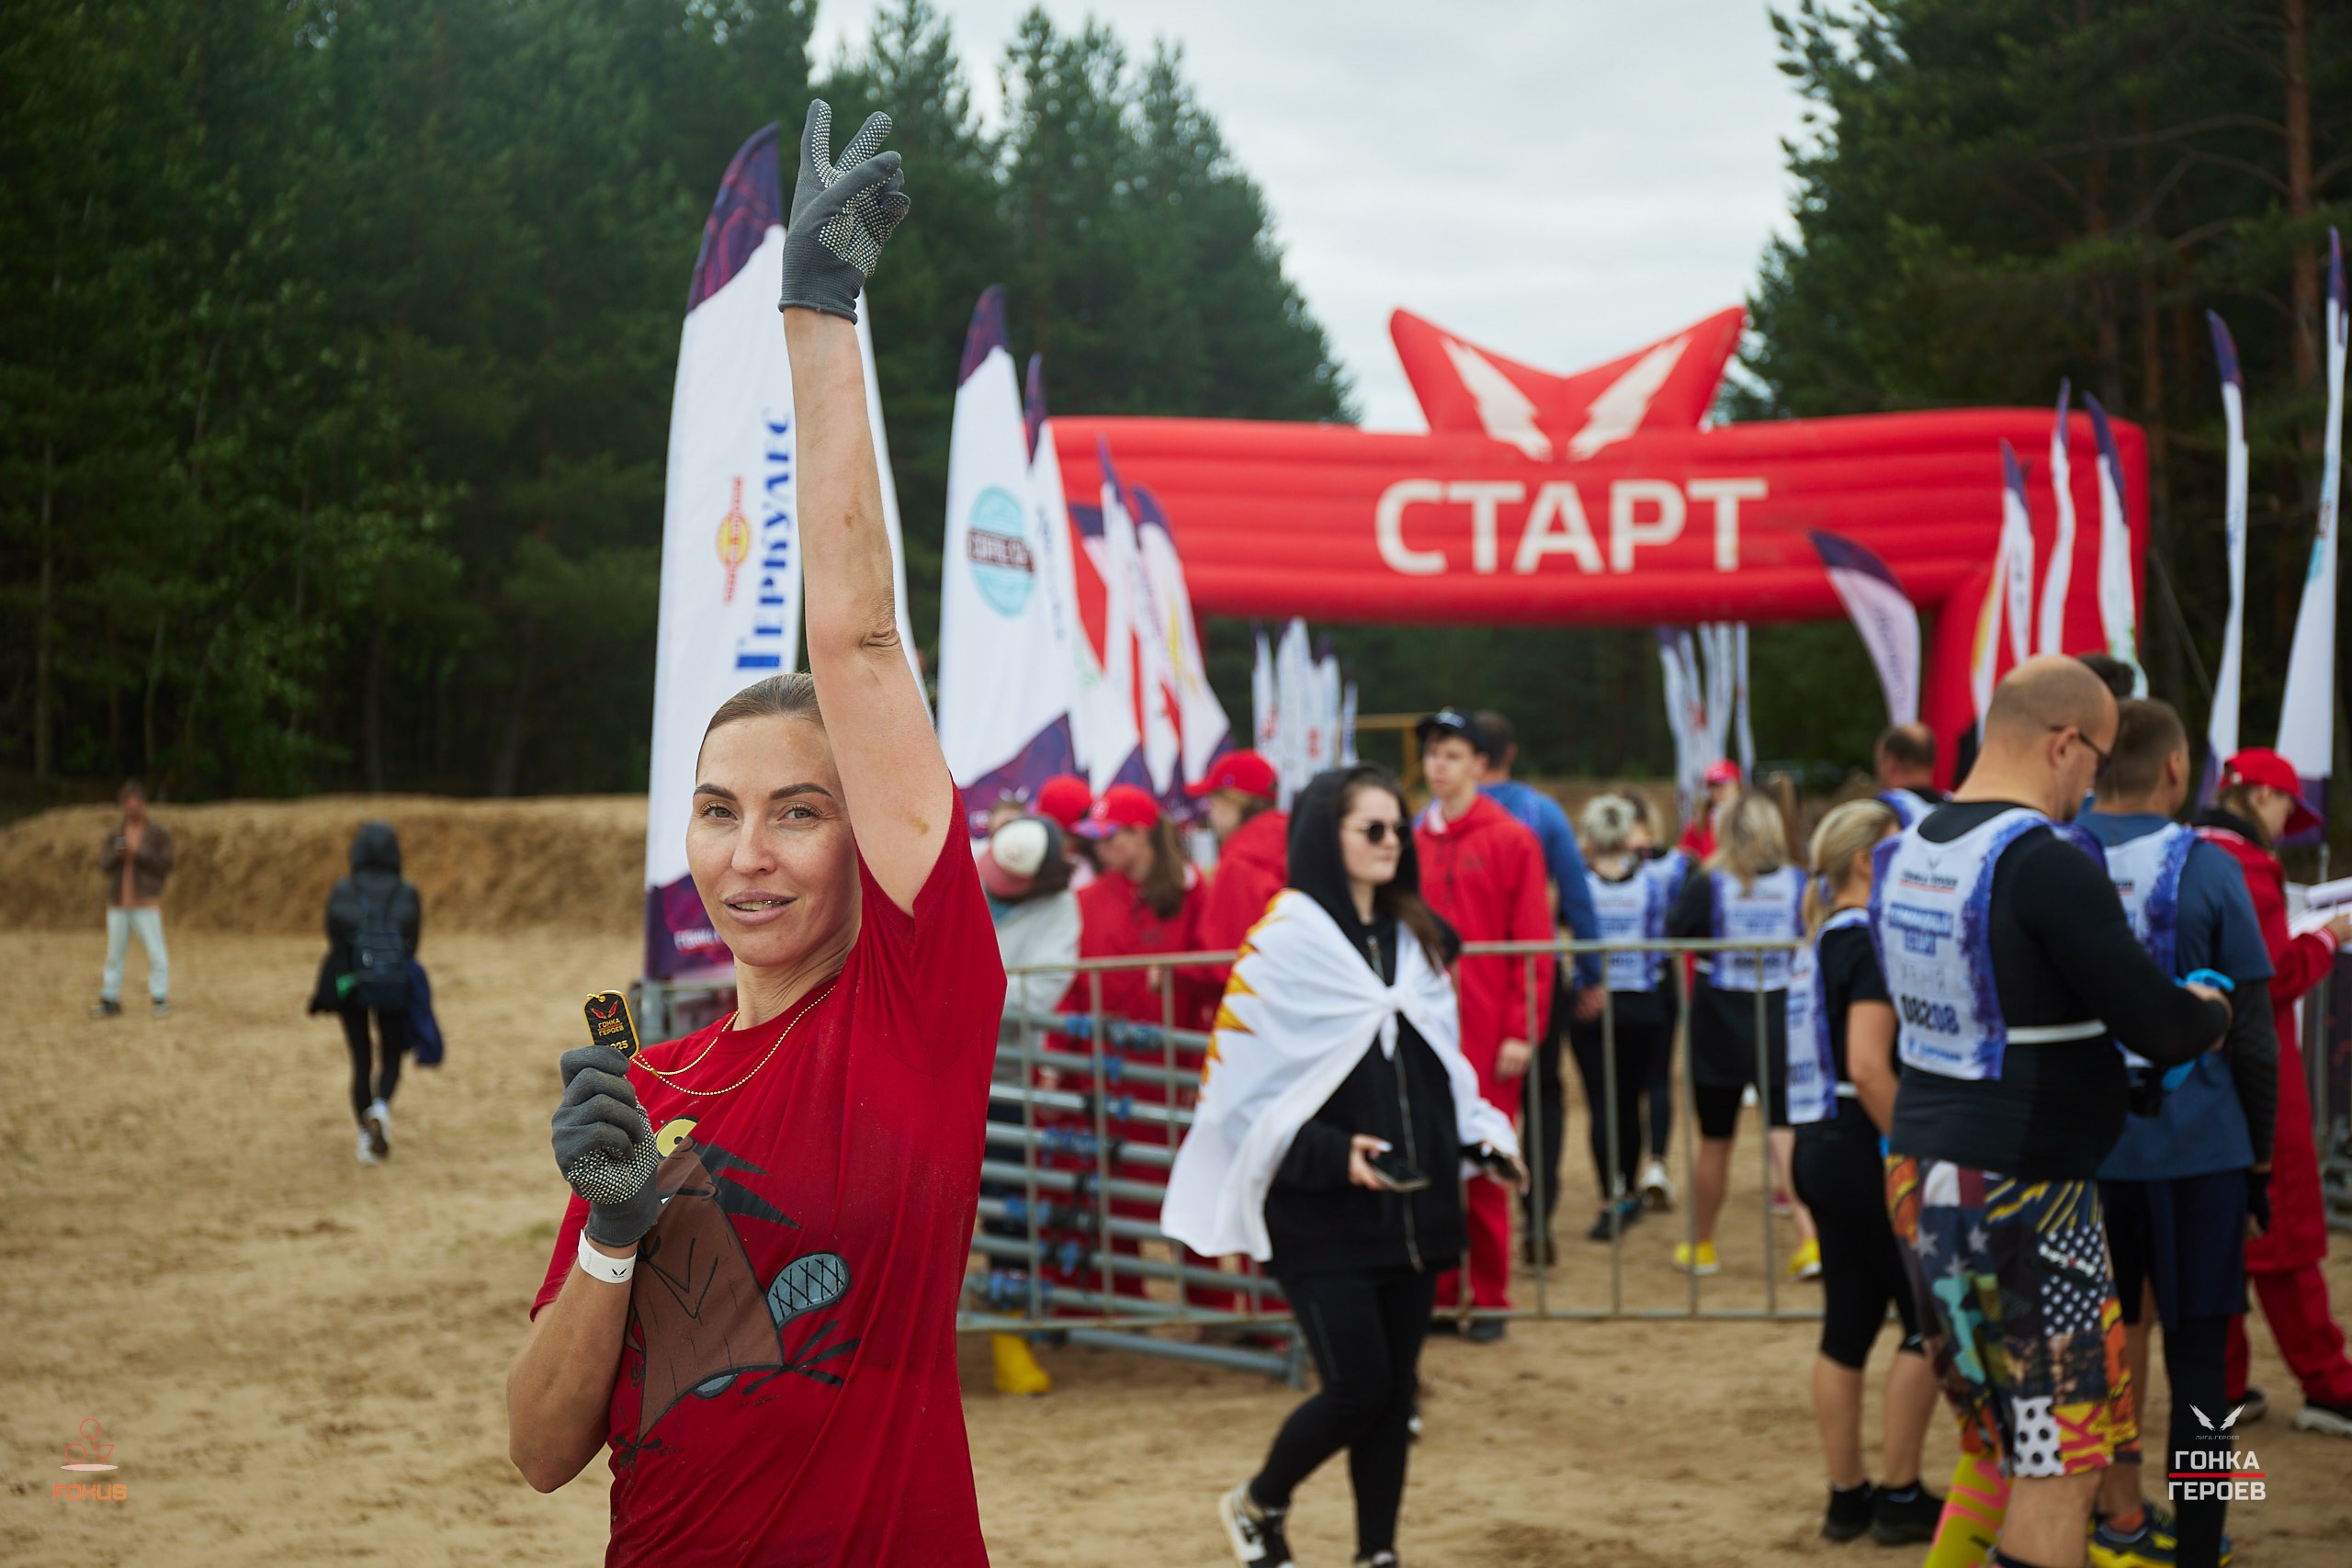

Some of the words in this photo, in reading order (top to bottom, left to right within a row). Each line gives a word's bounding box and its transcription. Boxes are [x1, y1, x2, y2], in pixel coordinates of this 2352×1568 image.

[1374, 478, 1769, 576] СТАРТ
[598, 1018, 621, 1029] ГОНКА
[1901, 994, 1961, 1036] 08208
[598, 1024, 625, 1037] ГЕРОЕВ
